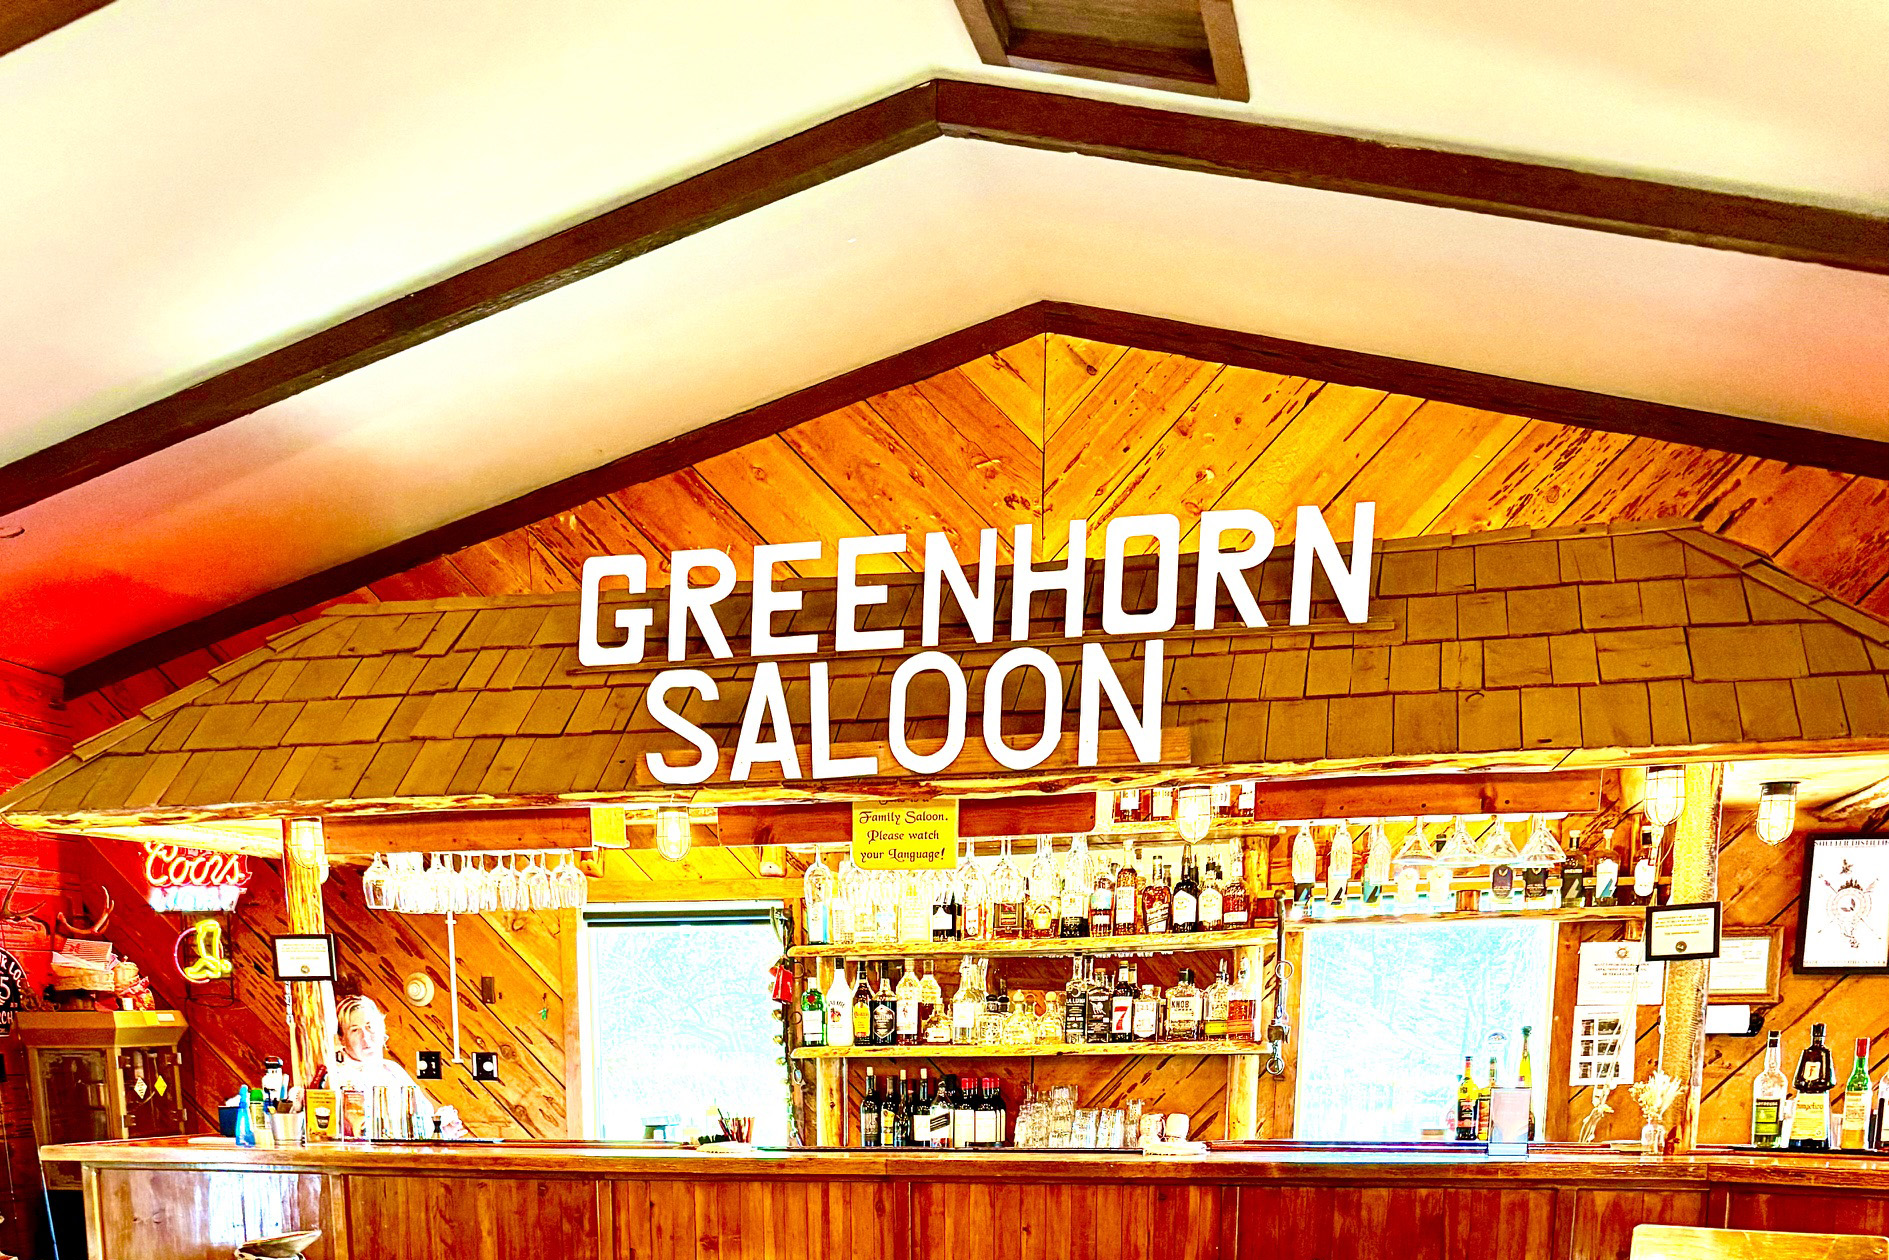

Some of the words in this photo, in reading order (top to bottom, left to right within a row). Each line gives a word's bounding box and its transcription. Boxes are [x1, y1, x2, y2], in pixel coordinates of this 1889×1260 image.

[578, 501, 1376, 667] GREENHORN
[644, 638, 1164, 785] SALOON
[859, 810, 901, 826] Family
[904, 810, 949, 825] Saloon.
[867, 829, 905, 845] Please
[908, 829, 940, 841] watch
[144, 840, 246, 886] Coors
[860, 851, 885, 863] your
[888, 847, 946, 863] Language!
[1171, 1000, 1190, 1009] KNOB
[1114, 1005, 1130, 1031] 7
